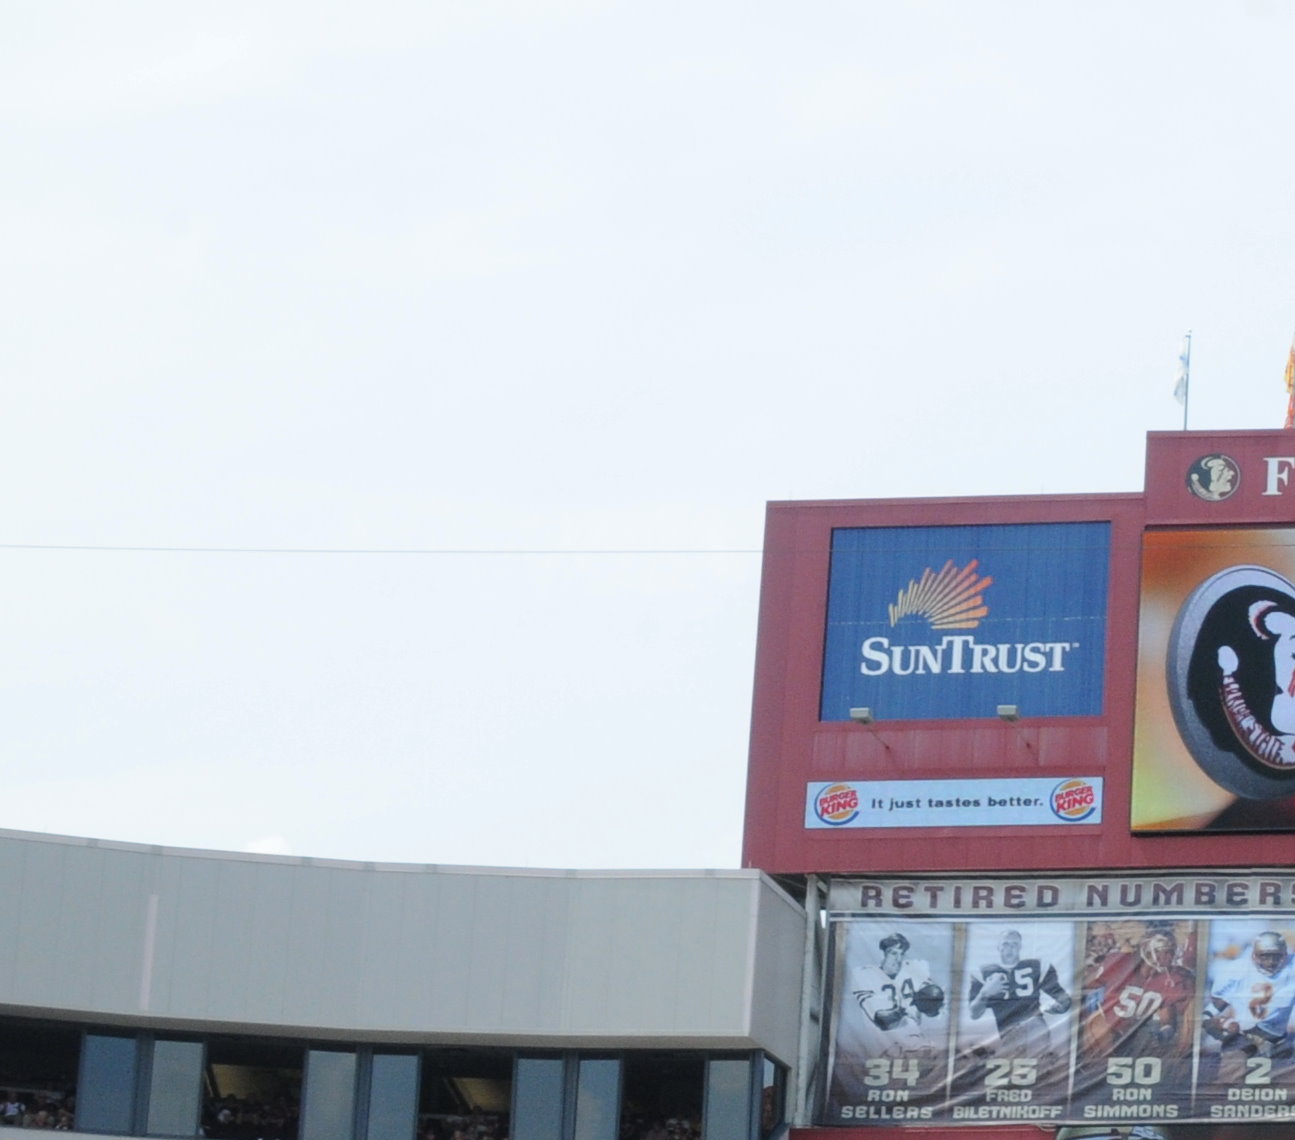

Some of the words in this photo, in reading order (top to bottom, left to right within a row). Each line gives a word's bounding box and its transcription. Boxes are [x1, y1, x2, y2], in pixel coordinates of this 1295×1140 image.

[819, 797, 859, 818] KING
[871, 797, 883, 810] It
[888, 796, 922, 813] just
[927, 796, 981, 809] tastes
[987, 795, 1045, 808] better.
[1055, 793, 1095, 814] KING
[860, 884, 1061, 910] RETIRED
[1113, 986, 1163, 1020] 50
[864, 1059, 921, 1087] 34
[984, 1058, 1038, 1087] 25
[1106, 1056, 1162, 1086] 50
[1244, 1056, 1272, 1086] 2
[867, 1089, 909, 1103] RON
[985, 1089, 1032, 1103] FRED
[1112, 1088, 1153, 1101] RON
[1228, 1087, 1289, 1101] DEION
[840, 1105, 933, 1120] SELLERS
[952, 1105, 1063, 1120] BILETNIKOFF
[1083, 1104, 1179, 1119] SIMMONS
